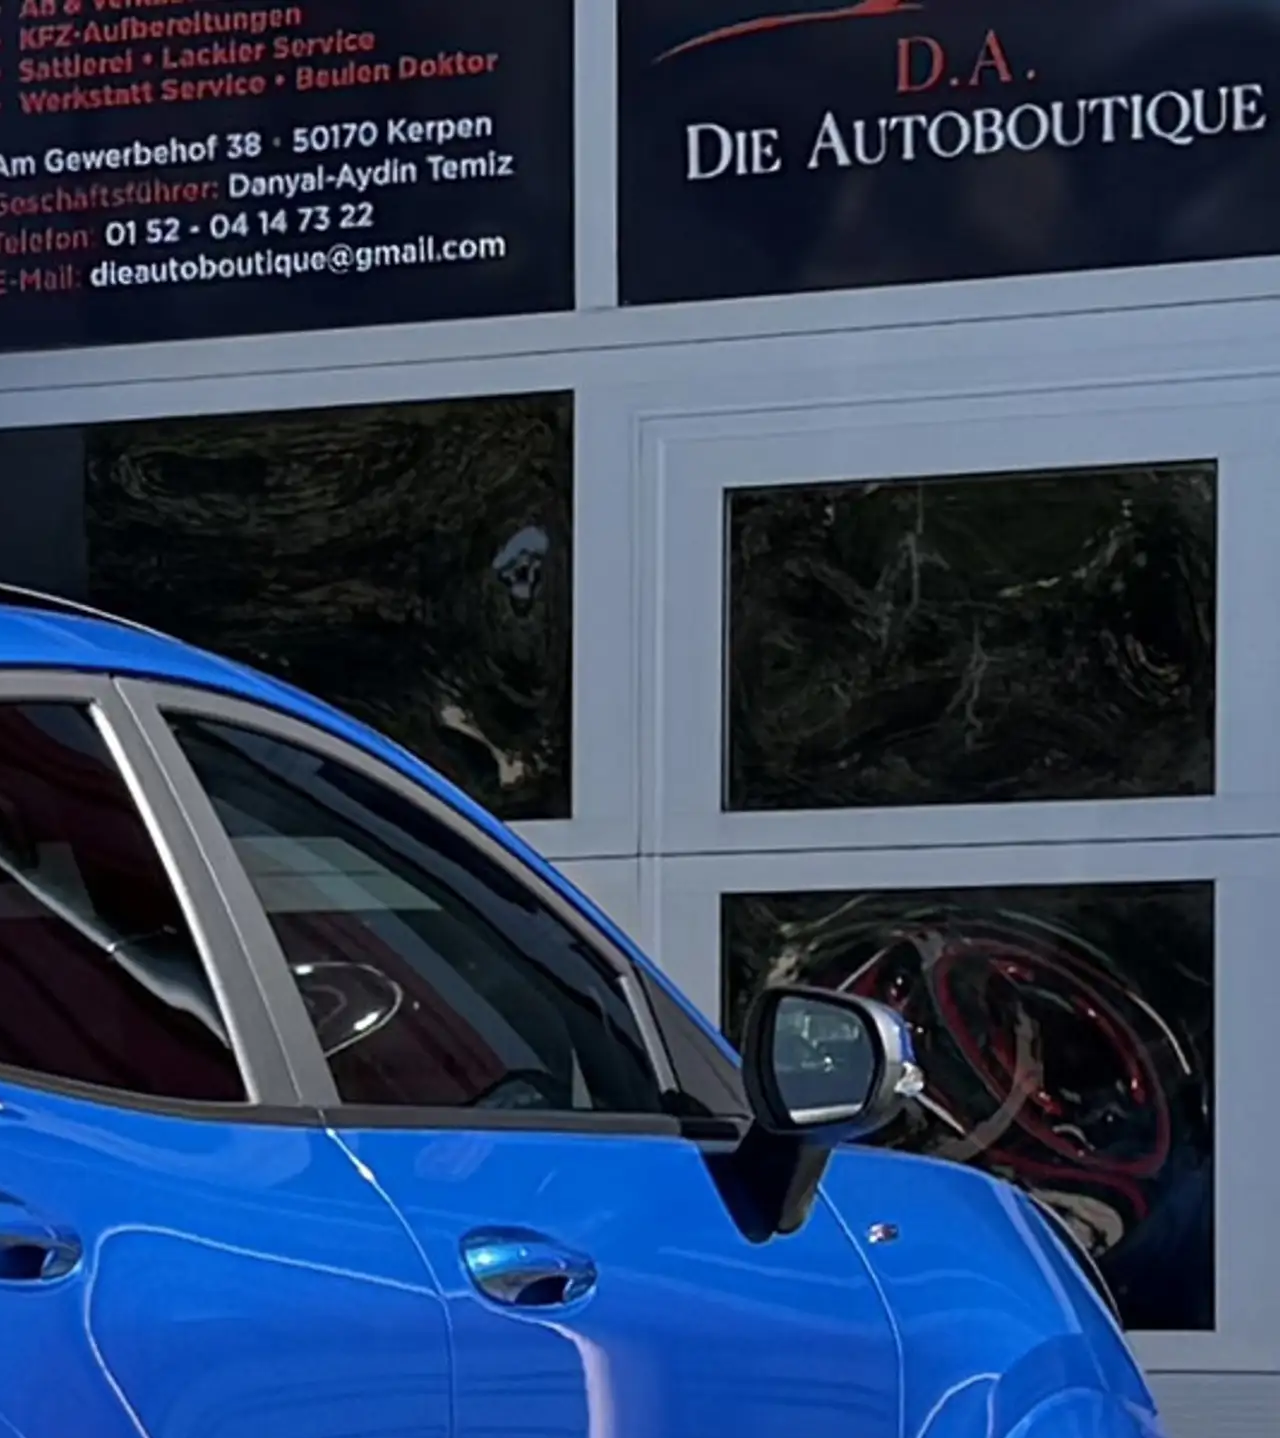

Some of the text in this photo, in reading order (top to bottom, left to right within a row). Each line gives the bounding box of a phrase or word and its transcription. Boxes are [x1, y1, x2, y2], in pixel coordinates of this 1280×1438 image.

[19, 6, 302, 50] KFZ-Aufbereitungen
[18, 29, 375, 83] Sattlerei Lackier Service
[18, 52, 499, 114] Werkstatt Service Beulen Doktor
[896, 29, 1037, 93] D.A.
[44, 134, 219, 173] Gewerbehof
[226, 132, 262, 159] 38
[292, 121, 378, 153] 50170
[387, 116, 493, 146] Kerpen
[807, 83, 1268, 170] AUTOBOUTIQUE
[229, 158, 417, 198] Danyal-Aydin
[426, 149, 514, 181] Temiz
[105, 220, 137, 246] 01
[145, 217, 181, 243] 52
[209, 212, 249, 240] 04
[258, 209, 288, 237] 14
[297, 205, 331, 232] 73
[339, 202, 375, 229] 22
[90, 235, 506, 287] dieautoboutique@gmail.com
